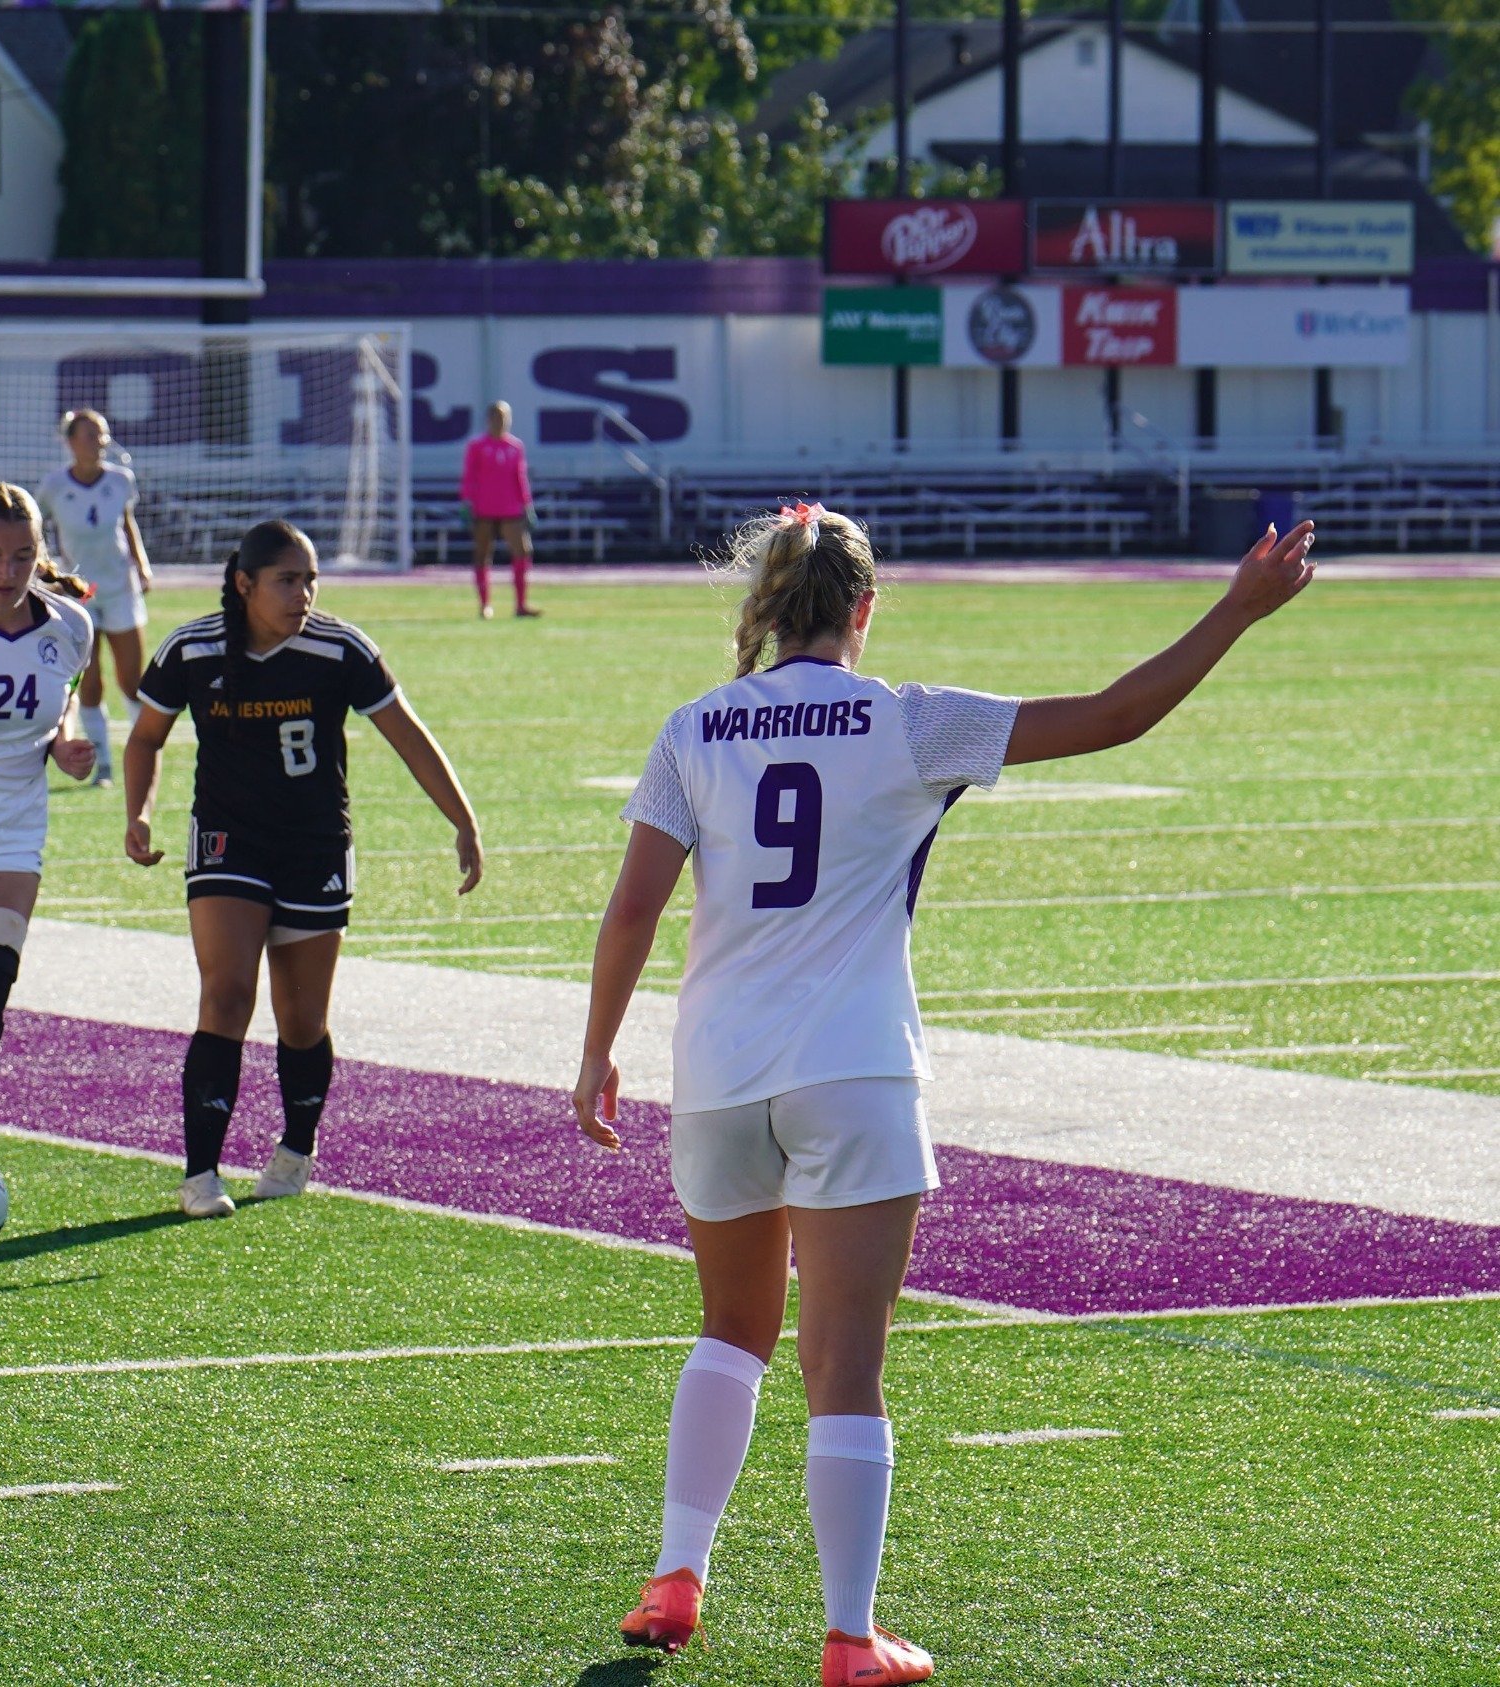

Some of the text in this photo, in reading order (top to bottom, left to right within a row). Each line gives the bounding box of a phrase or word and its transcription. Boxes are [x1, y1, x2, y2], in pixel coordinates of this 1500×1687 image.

[893, 213, 968, 265] Pepper
[1069, 205, 1179, 263] Altra
[86, 502, 98, 527] 4
[279, 718, 317, 777] 8
[702, 699, 873, 743] WARRIORS
[751, 761, 823, 909] 9
